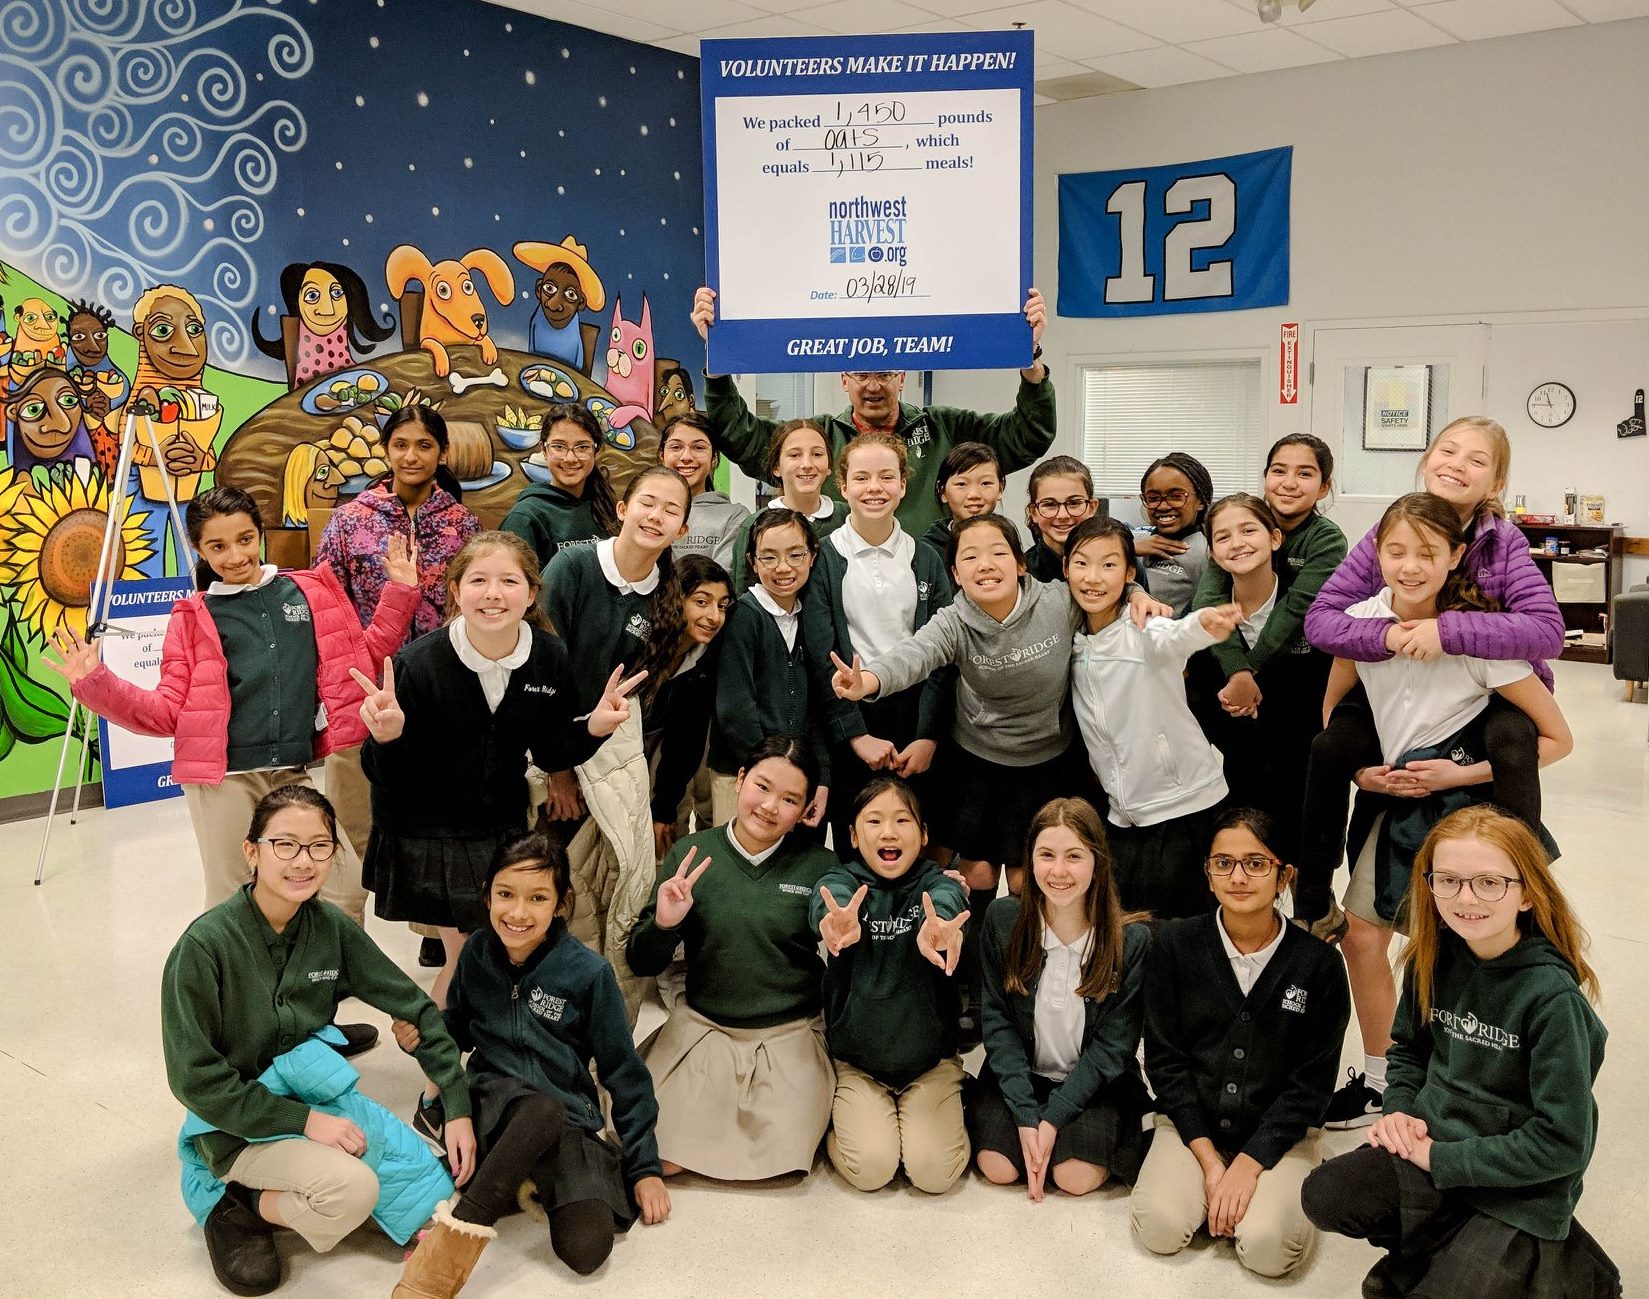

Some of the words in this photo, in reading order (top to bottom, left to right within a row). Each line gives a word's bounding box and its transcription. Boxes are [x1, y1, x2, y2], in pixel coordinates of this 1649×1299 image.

[720, 58, 843, 77] VOLUNTEERS
[846, 54, 903, 74] MAKE
[907, 55, 927, 72] IT
[928, 52, 1017, 72] HAPPEN!
[743, 116, 766, 130] We
[769, 115, 821, 132] packed
[837, 101, 906, 126] 1,450
[938, 111, 993, 127] pounds
[776, 138, 791, 151] of
[916, 134, 959, 148] which
[762, 160, 810, 176] equals
[830, 151, 884, 178] 1,115
[925, 156, 974, 170] meals!
[829, 195, 907, 219] northwest
[830, 218, 907, 245] HARVEST
[1104, 171, 1238, 305] 12
[884, 246, 907, 266] .org
[810, 290, 837, 300] Date:
[846, 269, 917, 303] 03/28/19
[1284, 330, 1296, 338] FIRE
[787, 338, 848, 356] GREAT
[848, 337, 890, 358] JOB,
[894, 336, 953, 353] TEAM!
[1635, 395, 1643, 403] 12
[686, 536, 721, 545] RIDGE
[110, 589, 184, 606] OLUNTEERS
[142, 643, 152, 652] of
[1021, 633, 1060, 658] RIDGE
[540, 999, 565, 1012] RIDGE
[543, 993, 567, 1004] FOREST
